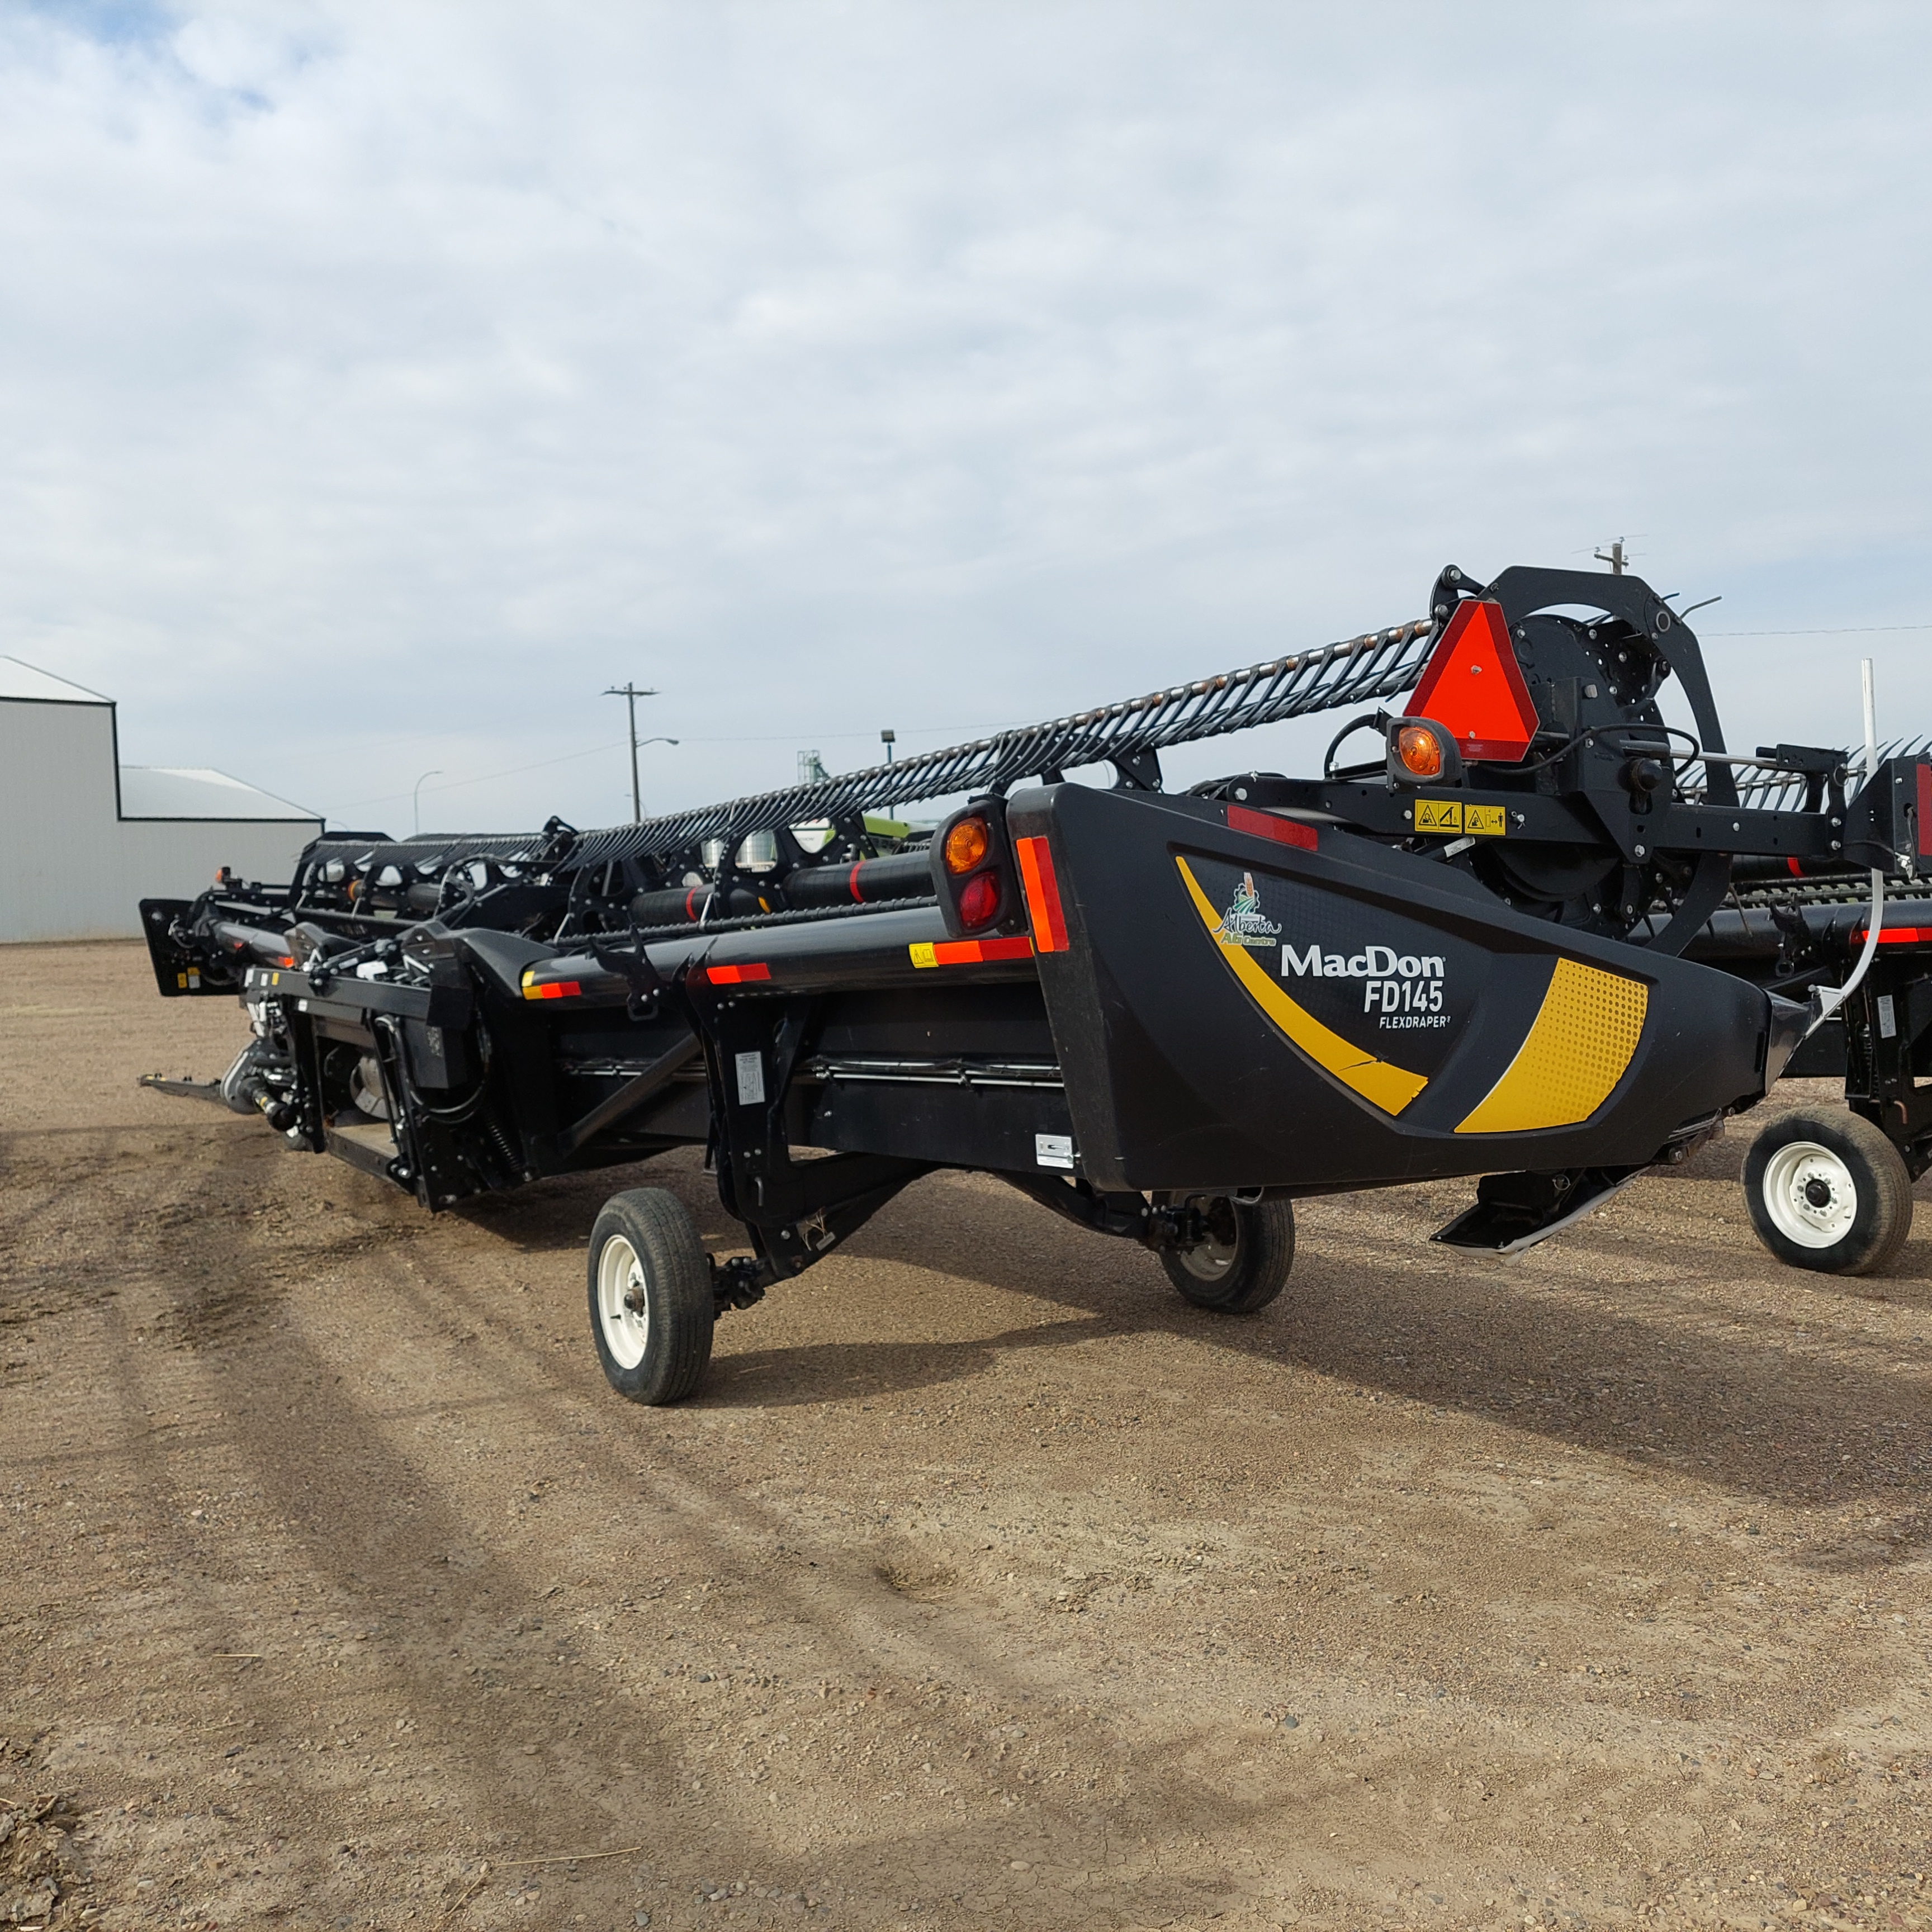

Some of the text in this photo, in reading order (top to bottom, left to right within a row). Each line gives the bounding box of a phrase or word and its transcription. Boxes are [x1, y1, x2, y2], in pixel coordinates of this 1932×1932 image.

[1212, 908, 1281, 933] Alberta
[1220, 933, 1242, 944] AG
[1281, 945, 1445, 977] MacDon
[1364, 981, 1443, 1012] FD145
